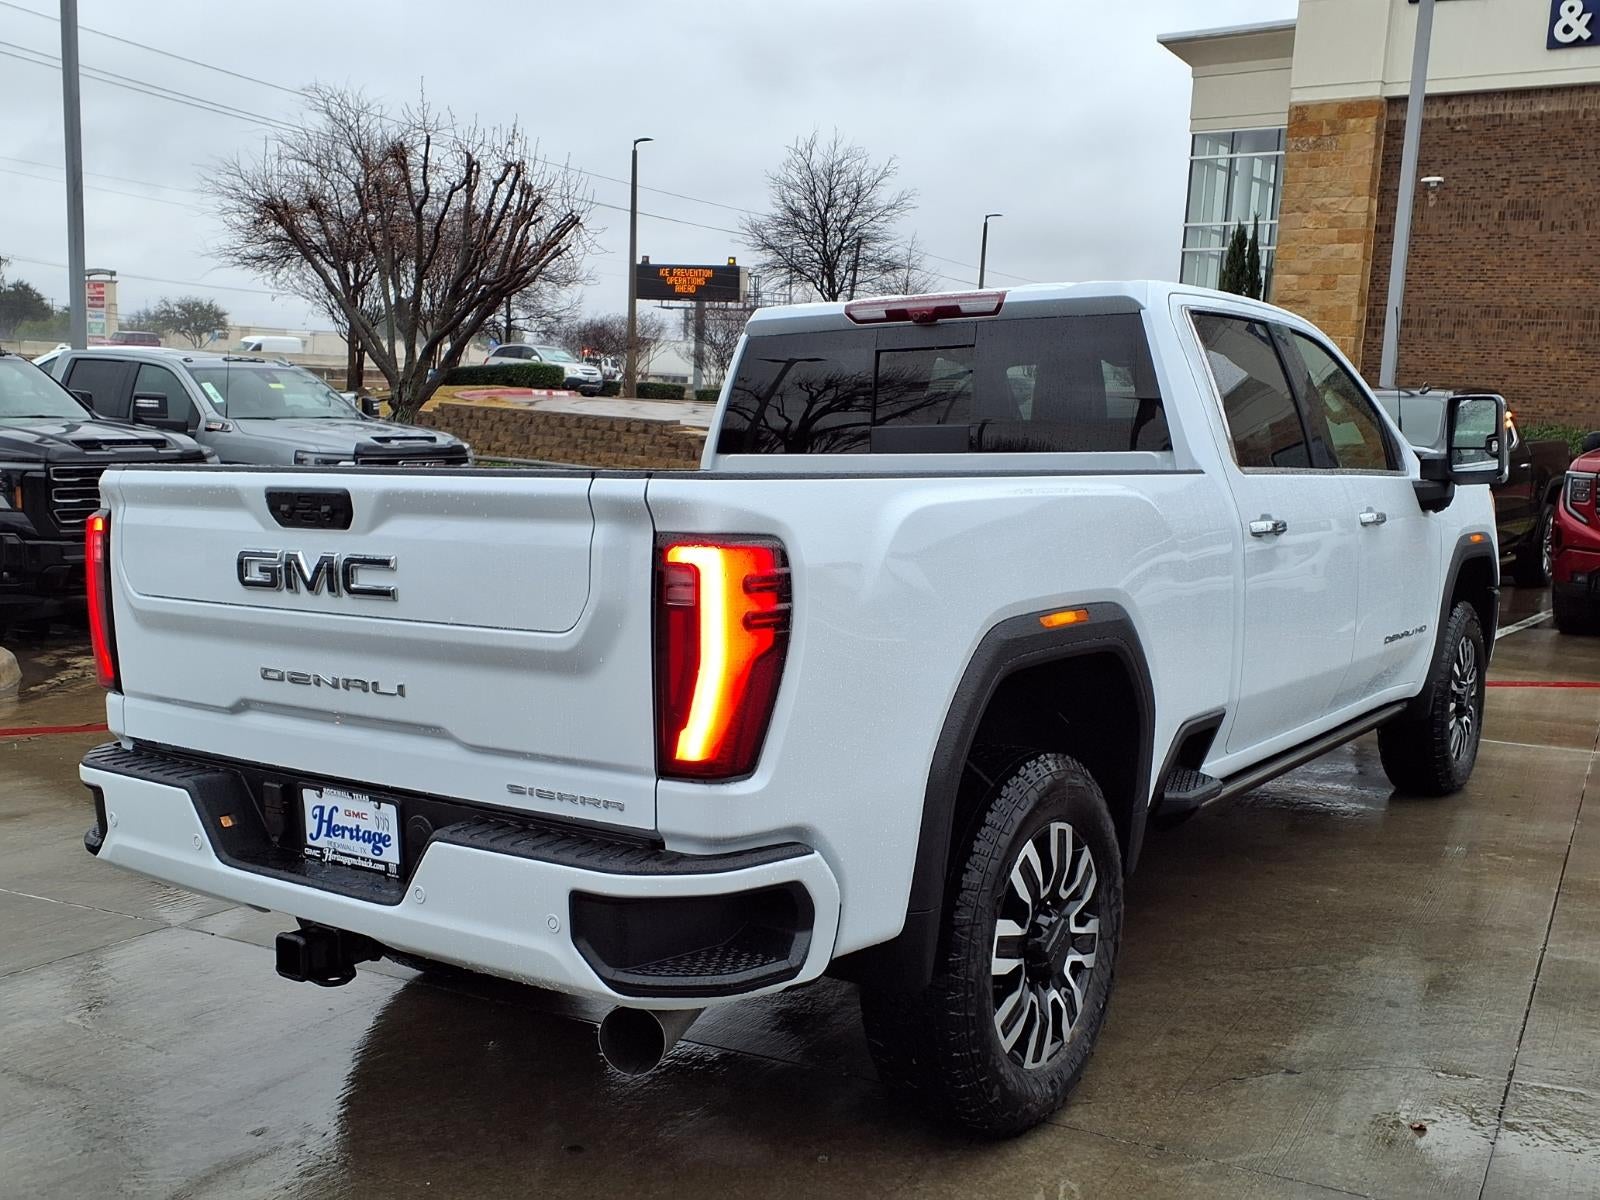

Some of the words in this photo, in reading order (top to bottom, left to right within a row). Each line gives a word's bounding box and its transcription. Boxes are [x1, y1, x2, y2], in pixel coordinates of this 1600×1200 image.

[1553, 0, 1593, 43] &
[660, 268, 670, 277] ICE
[673, 268, 713, 278] PREVENTION
[667, 277, 706, 286] OPERATIONS
[675, 285, 696, 293] AHEAD
[236, 548, 399, 601] GMC
[1415, 625, 1427, 635] HD
[260, 667, 406, 697] DENALI
[353, 793, 370, 802] TEXAS
[506, 783, 625, 812] SIERRA
[344, 809, 368, 820] GMC
[309, 804, 392, 856] Heritage
[304, 847, 321, 857] GMC
[360, 846, 367, 855] TX
